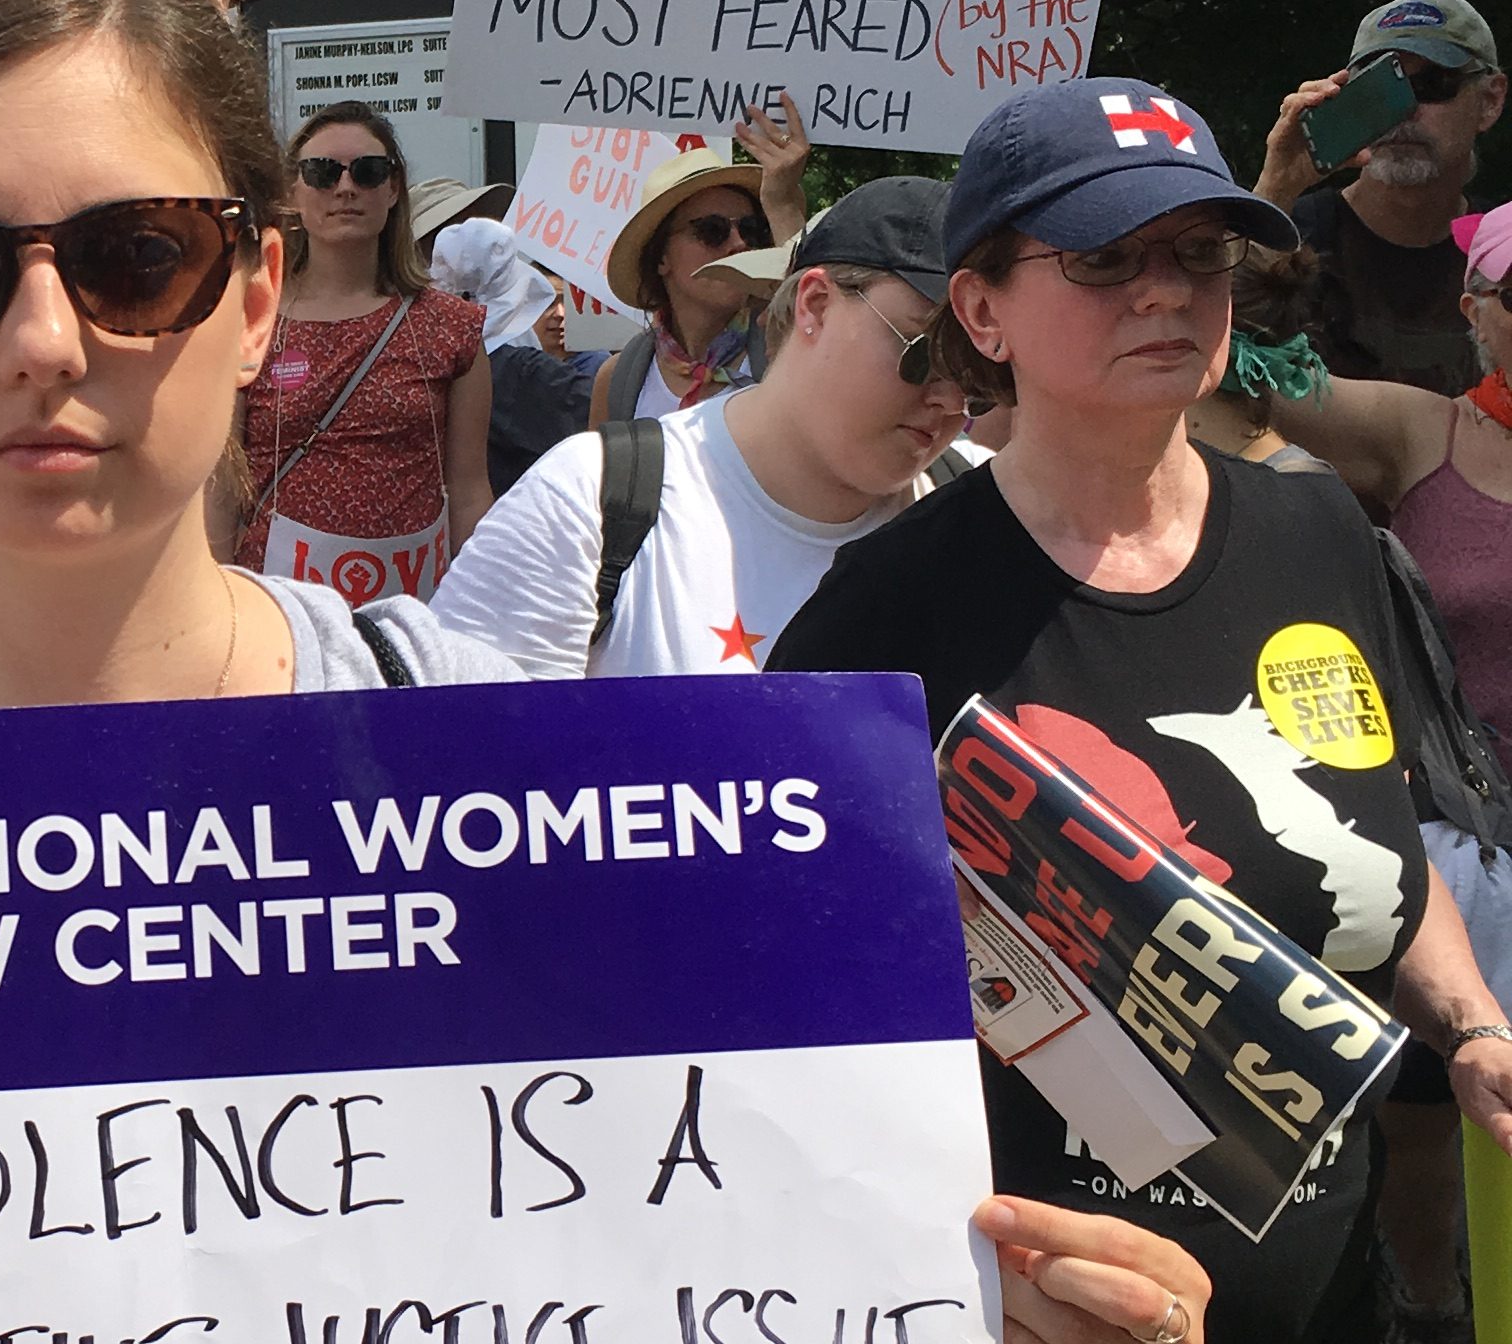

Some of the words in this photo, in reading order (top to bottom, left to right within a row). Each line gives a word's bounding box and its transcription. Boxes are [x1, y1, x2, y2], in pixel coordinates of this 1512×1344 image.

[397, 38, 413, 54] LPC
[422, 37, 447, 53] SUITE
[977, 27, 1083, 89] NRA)
[296, 75, 332, 91] SHONNA
[372, 71, 398, 87] LCSW
[424, 68, 445, 83] SUIT
[813, 83, 910, 134] RICH
[569, 155, 636, 212] GUN
[1263, 653, 1364, 675] BACKGROUND
[1267, 665, 1372, 695] CHECKS
[1291, 689, 1377, 721] SAVE
[1297, 714, 1388, 745] LIVES
[331, 777, 828, 873] WOMEN'S
[54, 892, 461, 986] CENTER
[481, 1071, 594, 1219] IS
[646, 1064, 723, 1206] A
